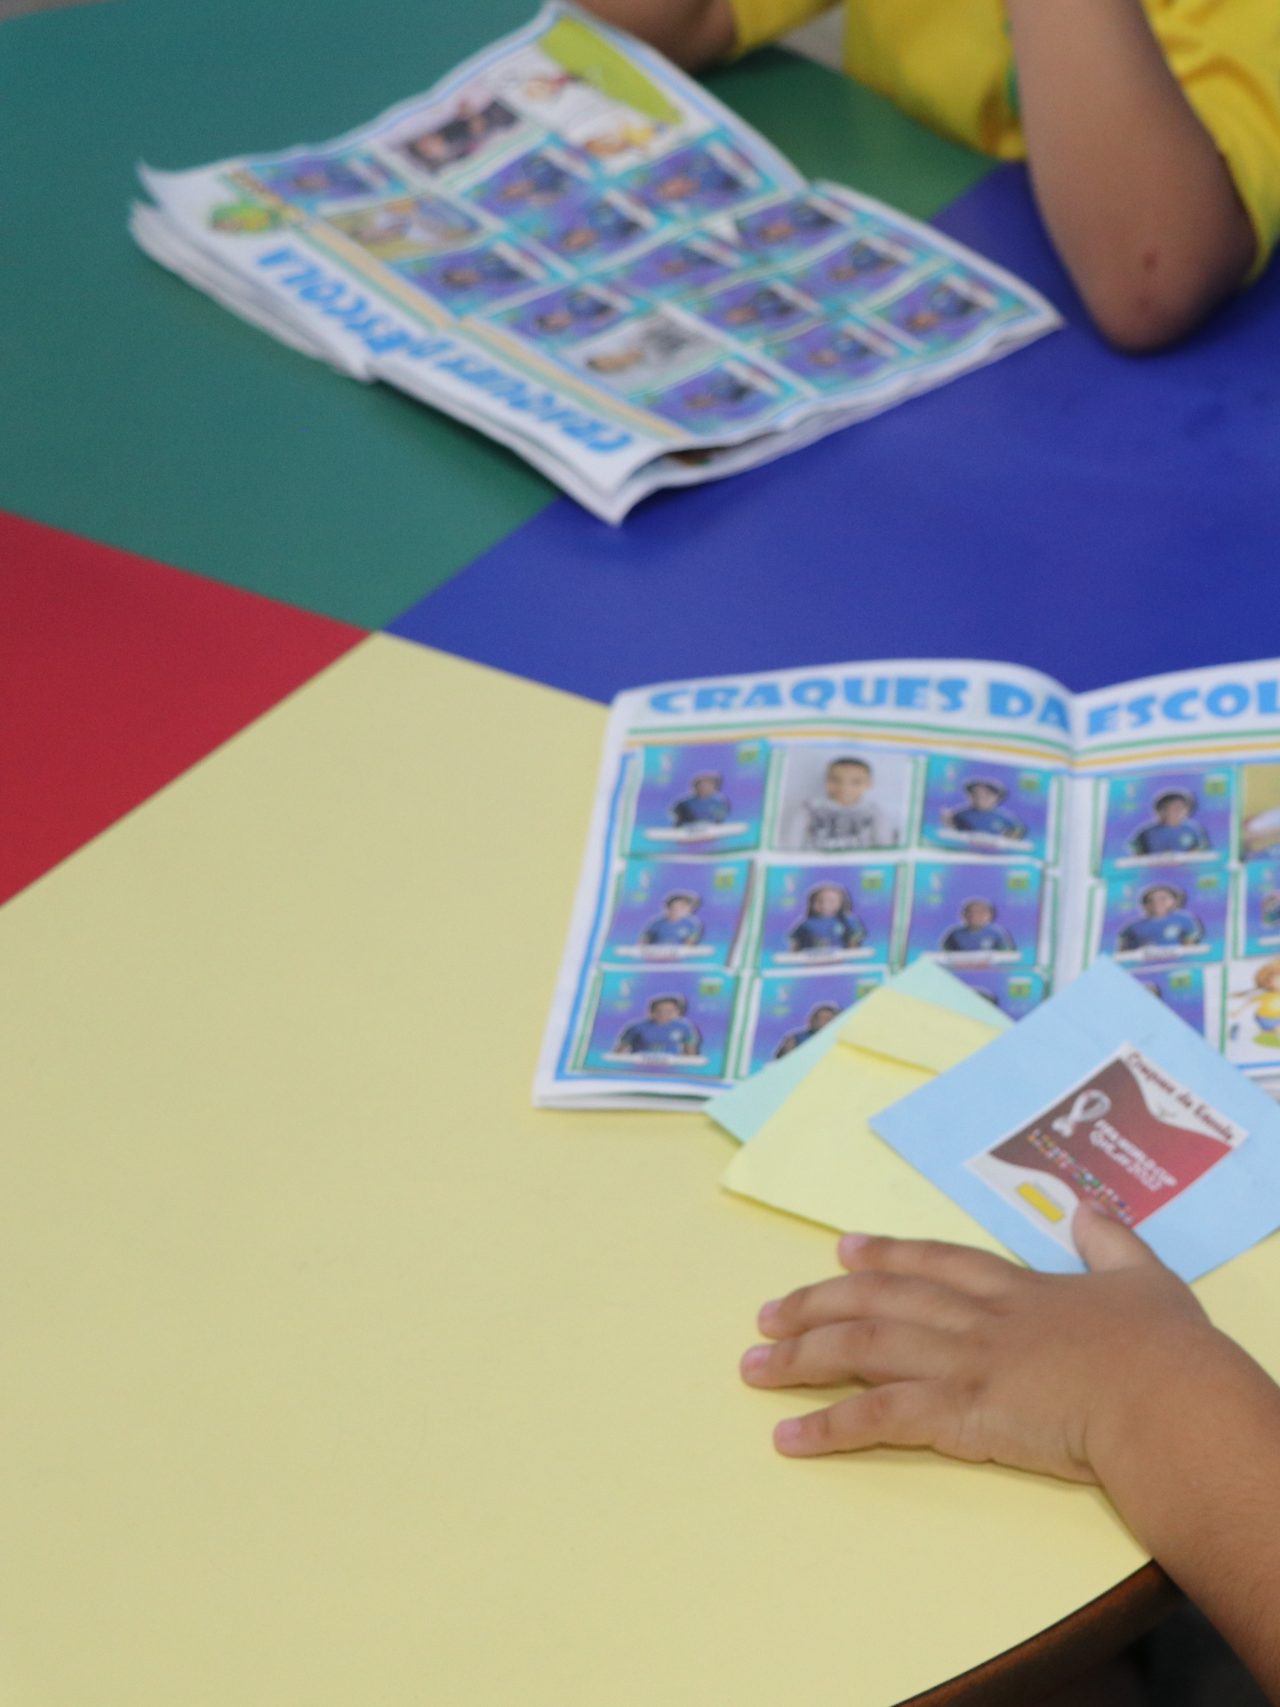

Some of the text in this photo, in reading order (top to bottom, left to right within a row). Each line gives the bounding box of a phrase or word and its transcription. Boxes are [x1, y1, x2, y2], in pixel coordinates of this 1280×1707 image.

[256, 247, 410, 354] ESCOLA
[649, 677, 969, 714] CRAQUES
[987, 680, 1071, 734] DA
